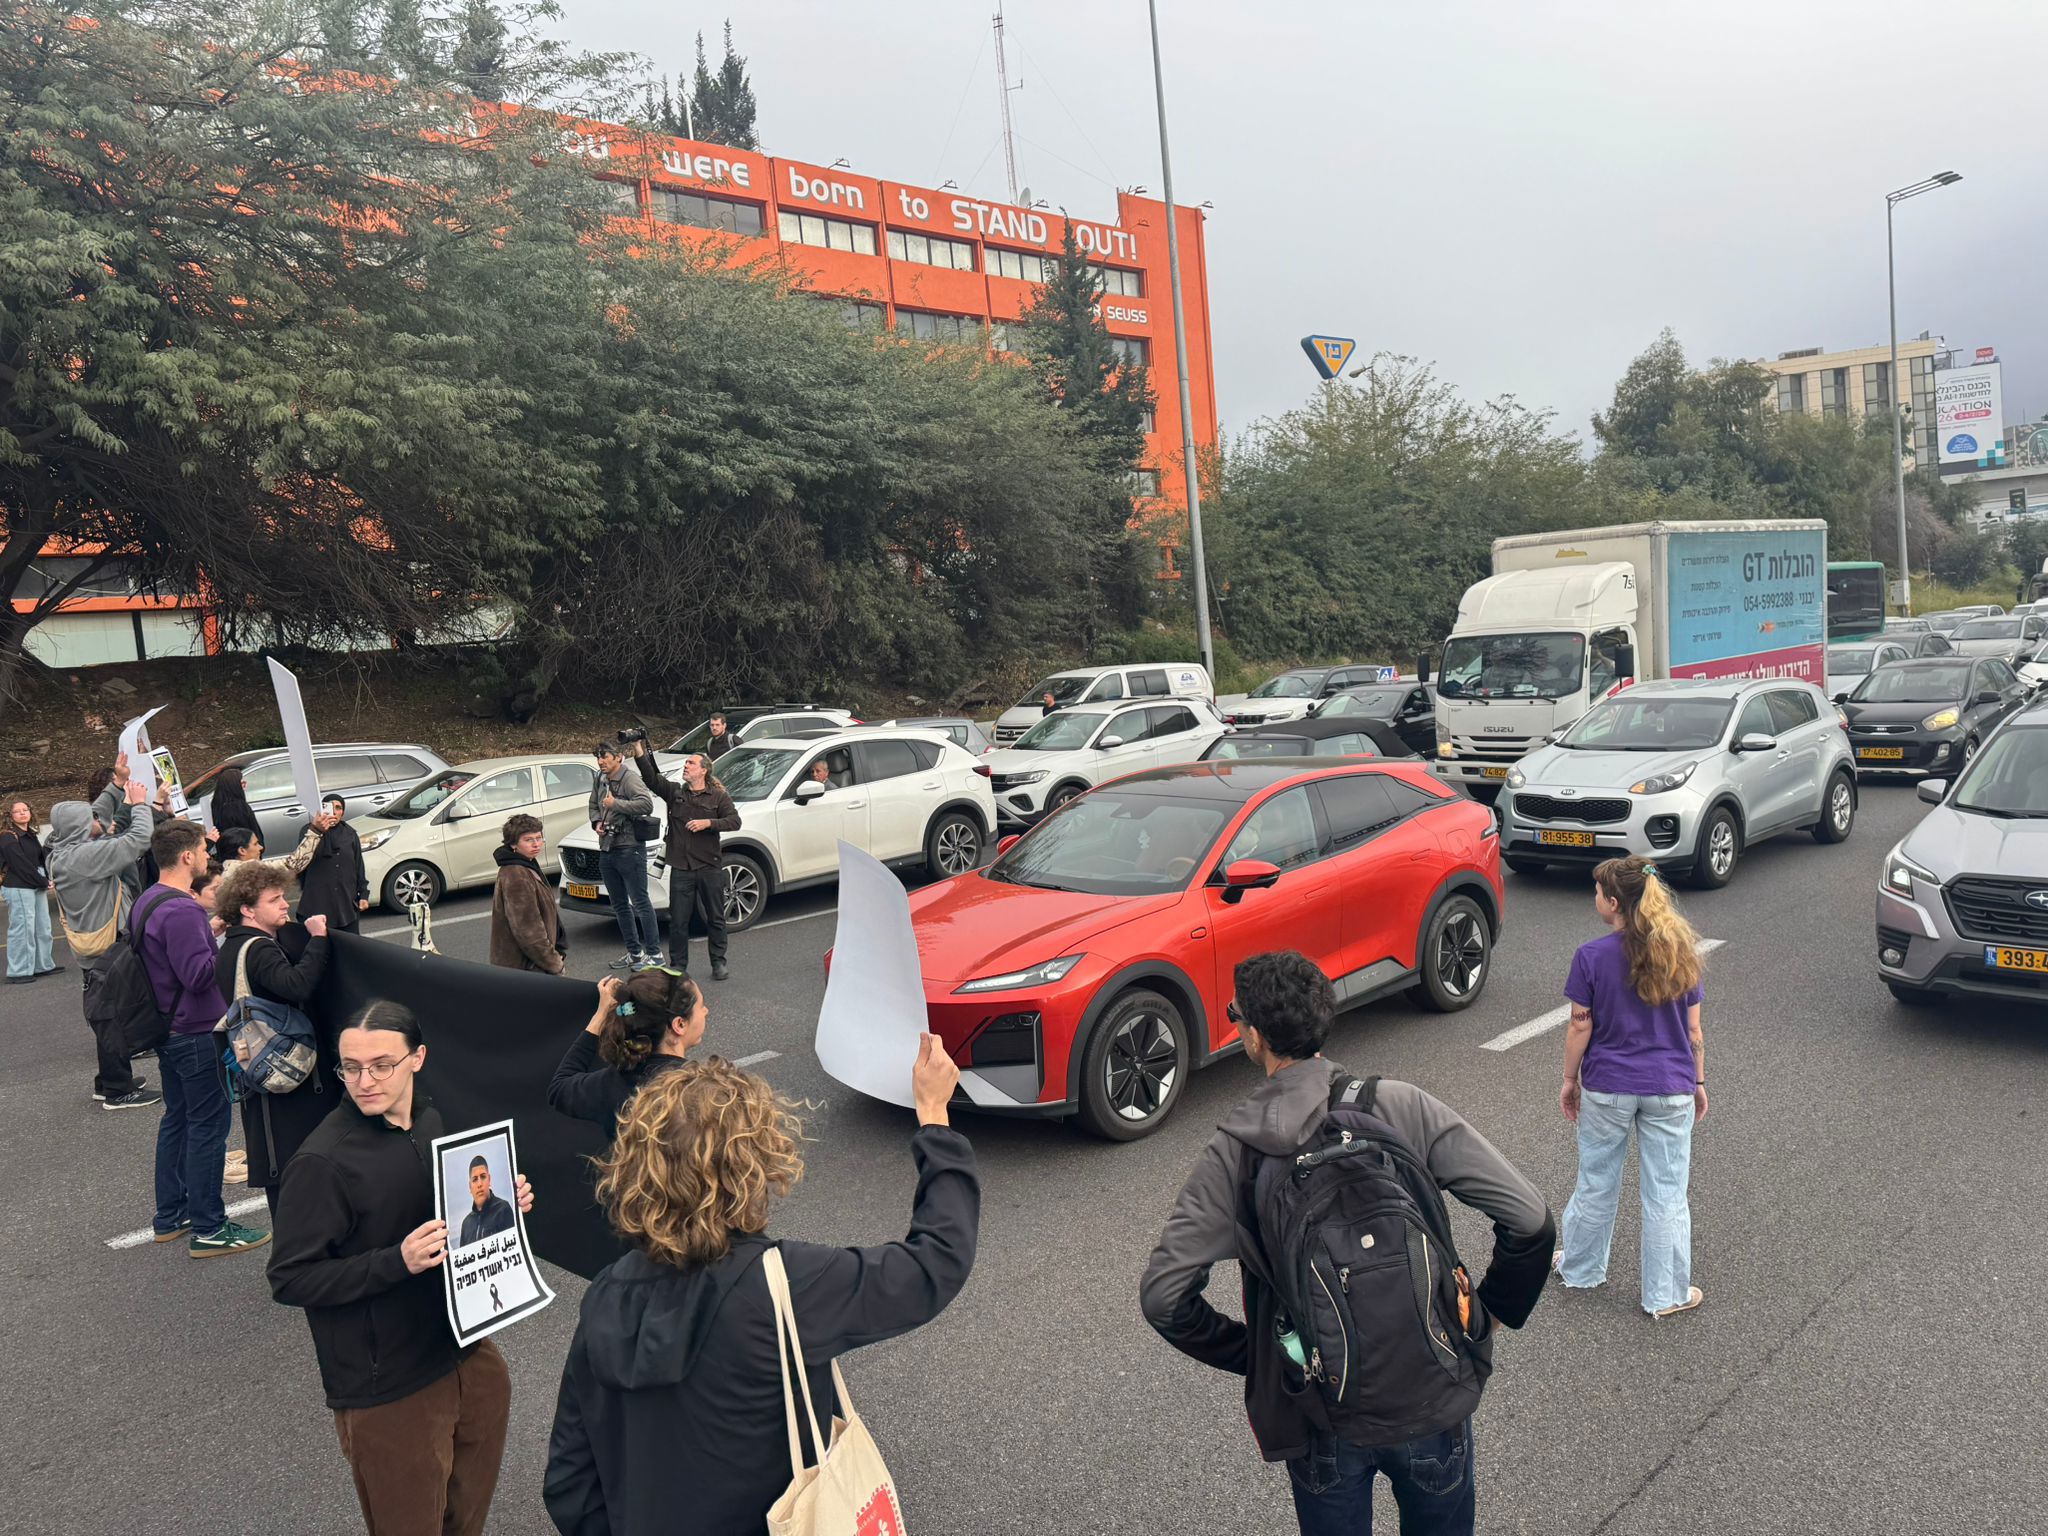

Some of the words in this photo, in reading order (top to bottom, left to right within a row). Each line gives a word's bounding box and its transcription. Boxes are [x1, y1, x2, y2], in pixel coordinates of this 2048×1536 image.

[663, 150, 750, 187] were
[789, 166, 865, 210] born
[899, 188, 929, 221] to
[950, 199, 1048, 245] STAND
[1076, 224, 1137, 261] OUT!
[1107, 306, 1148, 324] SEUSS
[1958, 389, 1991, 399] לחדשנות
[1966, 381, 1991, 391] הכנס
[1743, 552, 1764, 582] GT
[1768, 549, 1815, 580] הובלות
[1744, 591, 1794, 612] 054-5992388
[1756, 663, 1776, 679] שלי
[1779, 659, 1810, 678] הדירוג
[477, 1238, 500, 1260] أشرف
[501, 1234, 517, 1253] نبيل
[454, 1252, 476, 1271] صفية
[502, 1252, 522, 1270] נביל
[478, 1260, 504, 1282] אשרף
[455, 1271, 478, 1291] ספיה
